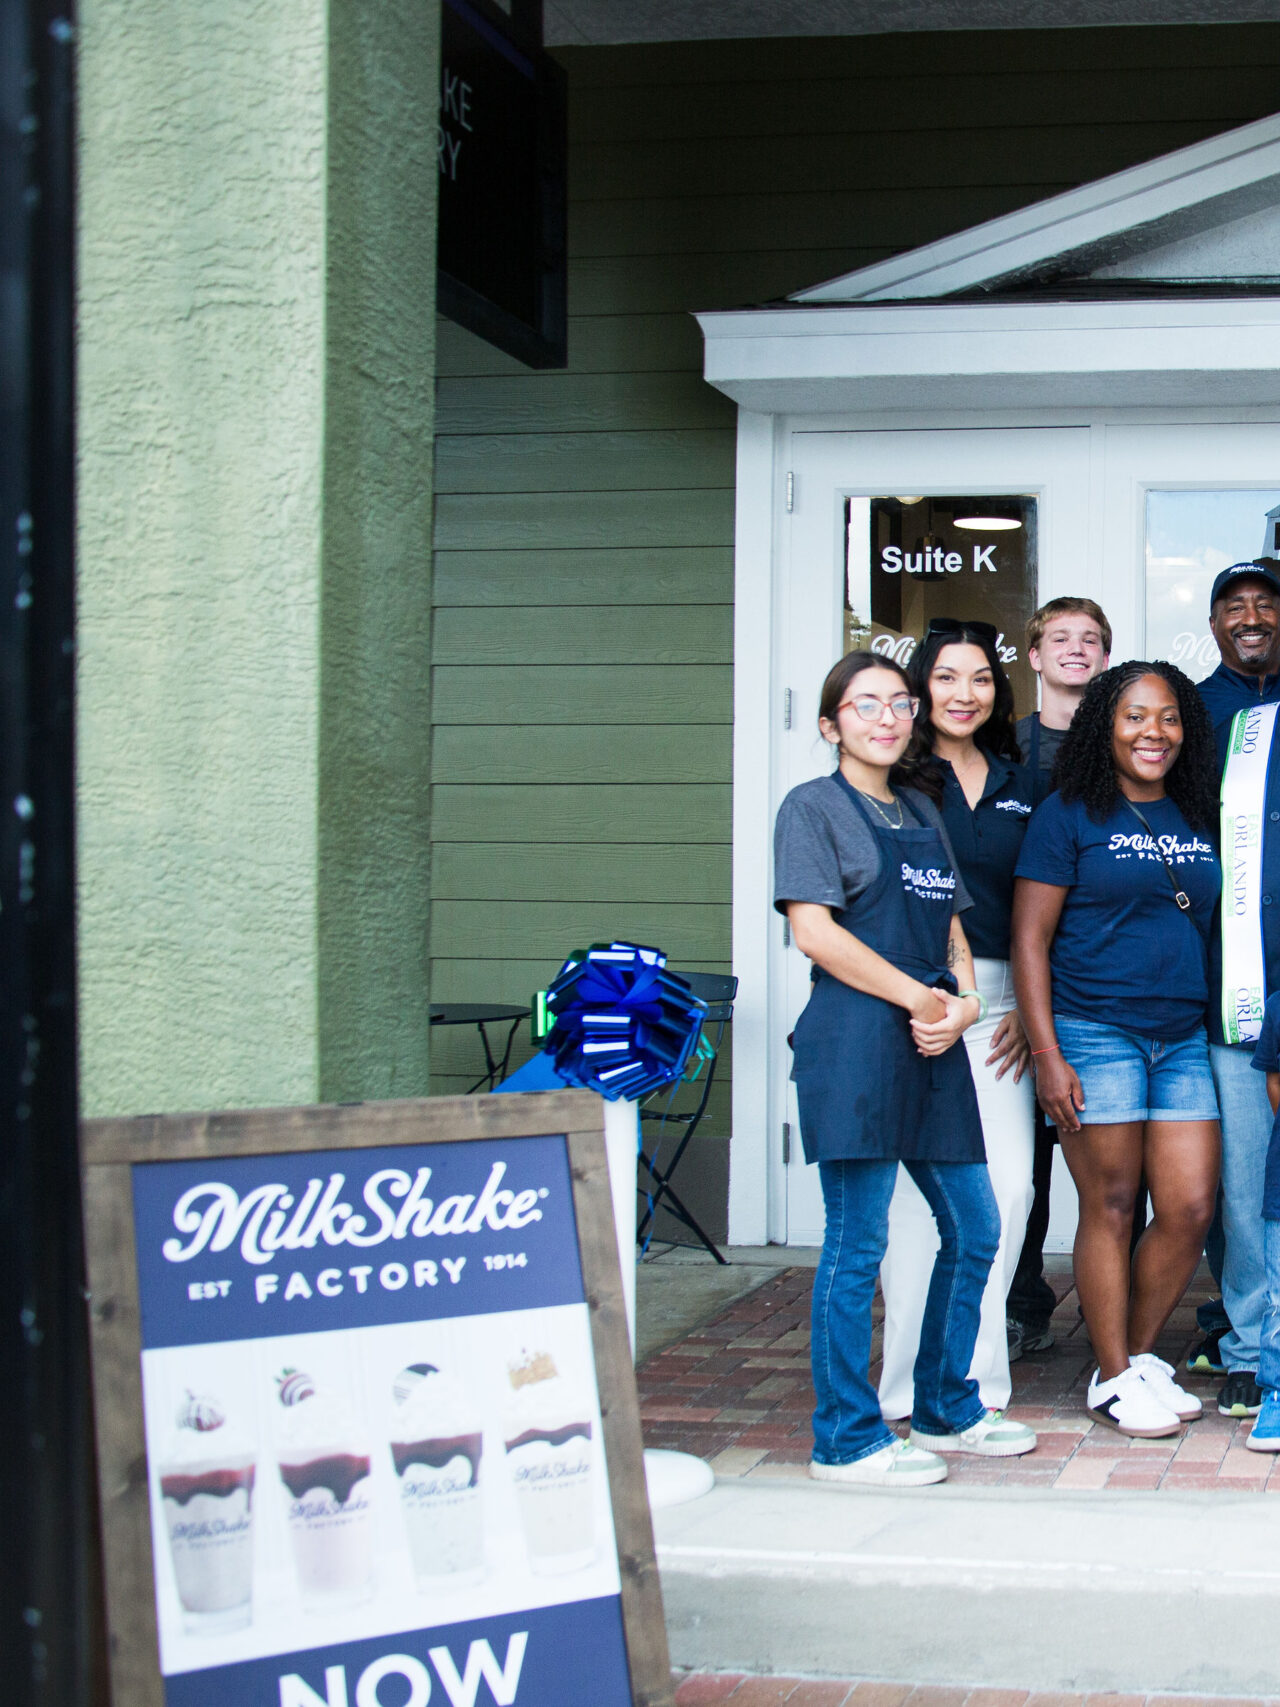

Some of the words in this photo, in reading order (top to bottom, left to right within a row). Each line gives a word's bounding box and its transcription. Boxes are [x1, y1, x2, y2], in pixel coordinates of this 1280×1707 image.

[881, 546, 963, 573] Suite
[973, 545, 998, 573] K
[1108, 833, 1212, 856] MilkShake
[1138, 851, 1196, 866] FACORY
[1234, 815, 1249, 916] ORLANDO
[1250, 986, 1263, 1022] EAST
[163, 1161, 546, 1265] MilkShake
[188, 1280, 233, 1301] EST
[255, 1256, 467, 1304] FACTORY
[484, 1253, 529, 1272] 1914
[279, 1631, 529, 1707] NOW
